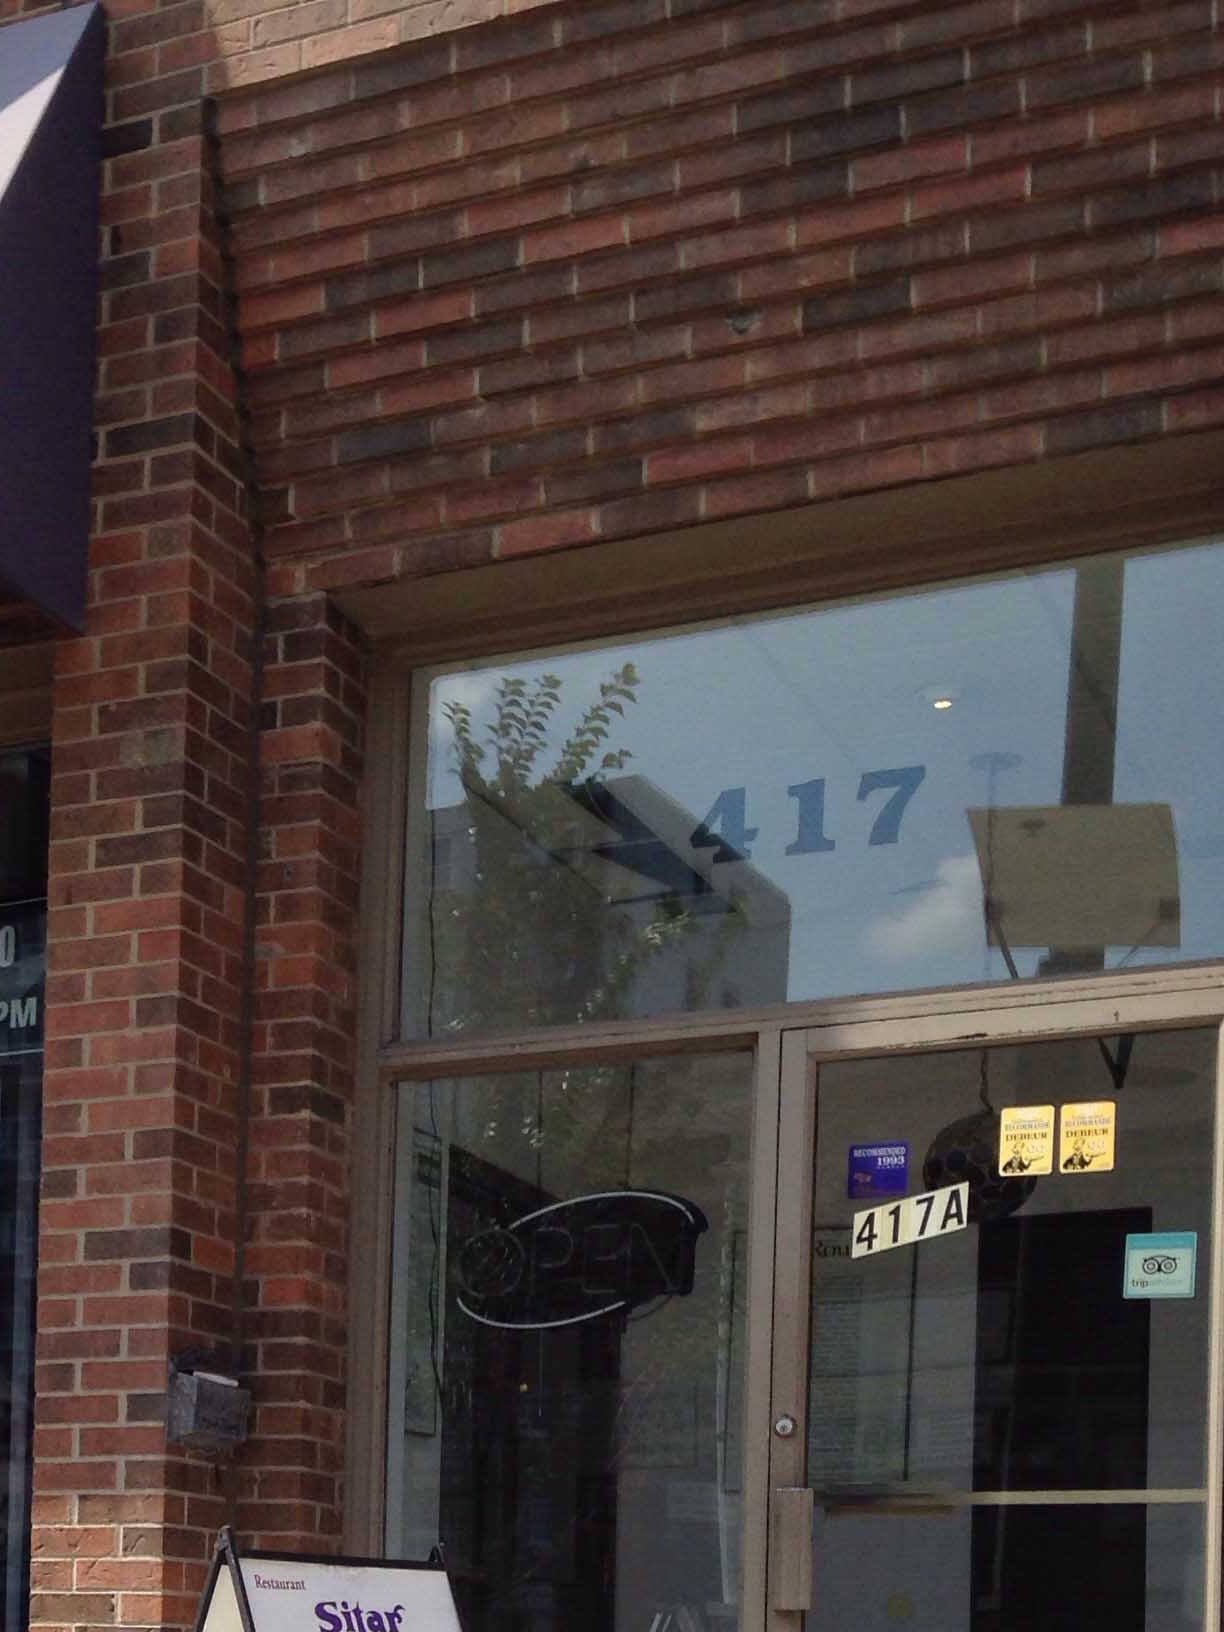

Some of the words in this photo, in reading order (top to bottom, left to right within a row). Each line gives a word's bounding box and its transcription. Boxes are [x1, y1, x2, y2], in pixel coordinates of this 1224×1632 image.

[689, 764, 926, 864] 417
[856, 1188, 964, 1251] 417A
[253, 1574, 308, 1591] Restaurant
